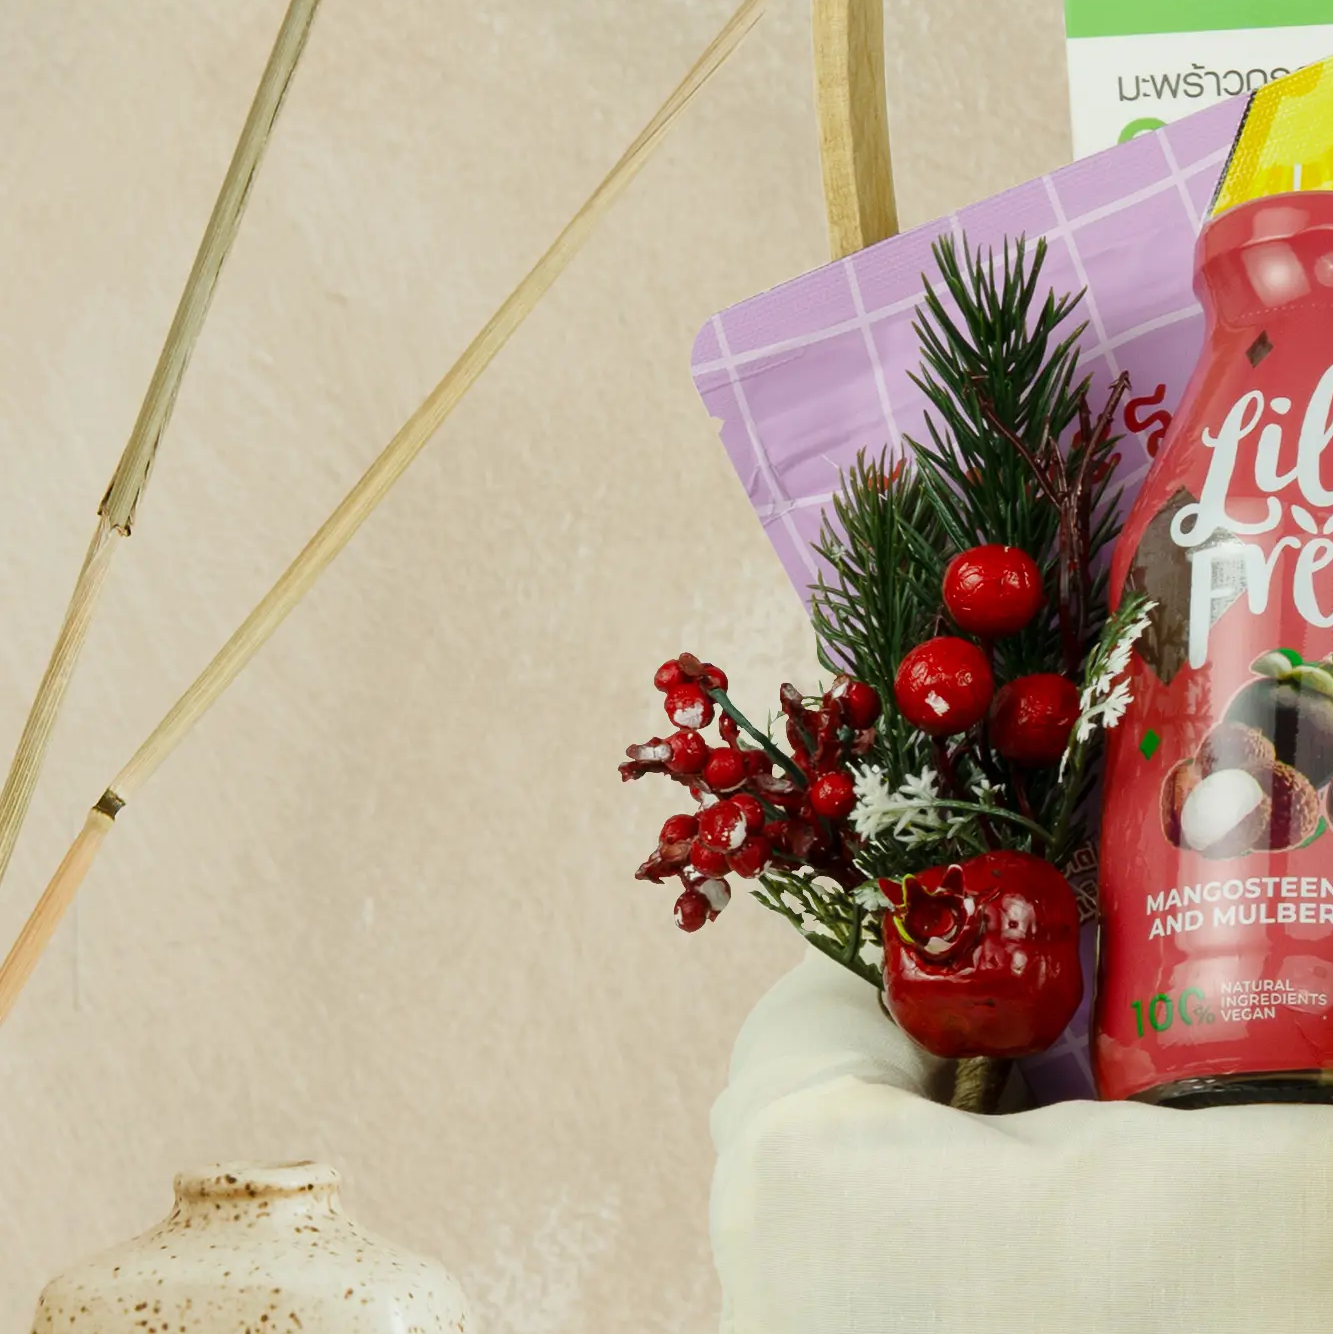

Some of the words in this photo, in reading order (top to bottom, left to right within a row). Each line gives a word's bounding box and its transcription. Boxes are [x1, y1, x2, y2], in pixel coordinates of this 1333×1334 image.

[1148, 909, 1204, 940] AND
[1220, 979, 1295, 994] NATURAL
[1220, 992, 1328, 1008] INGREDIENTS
[1220, 1007, 1276, 1022] VEGAN
